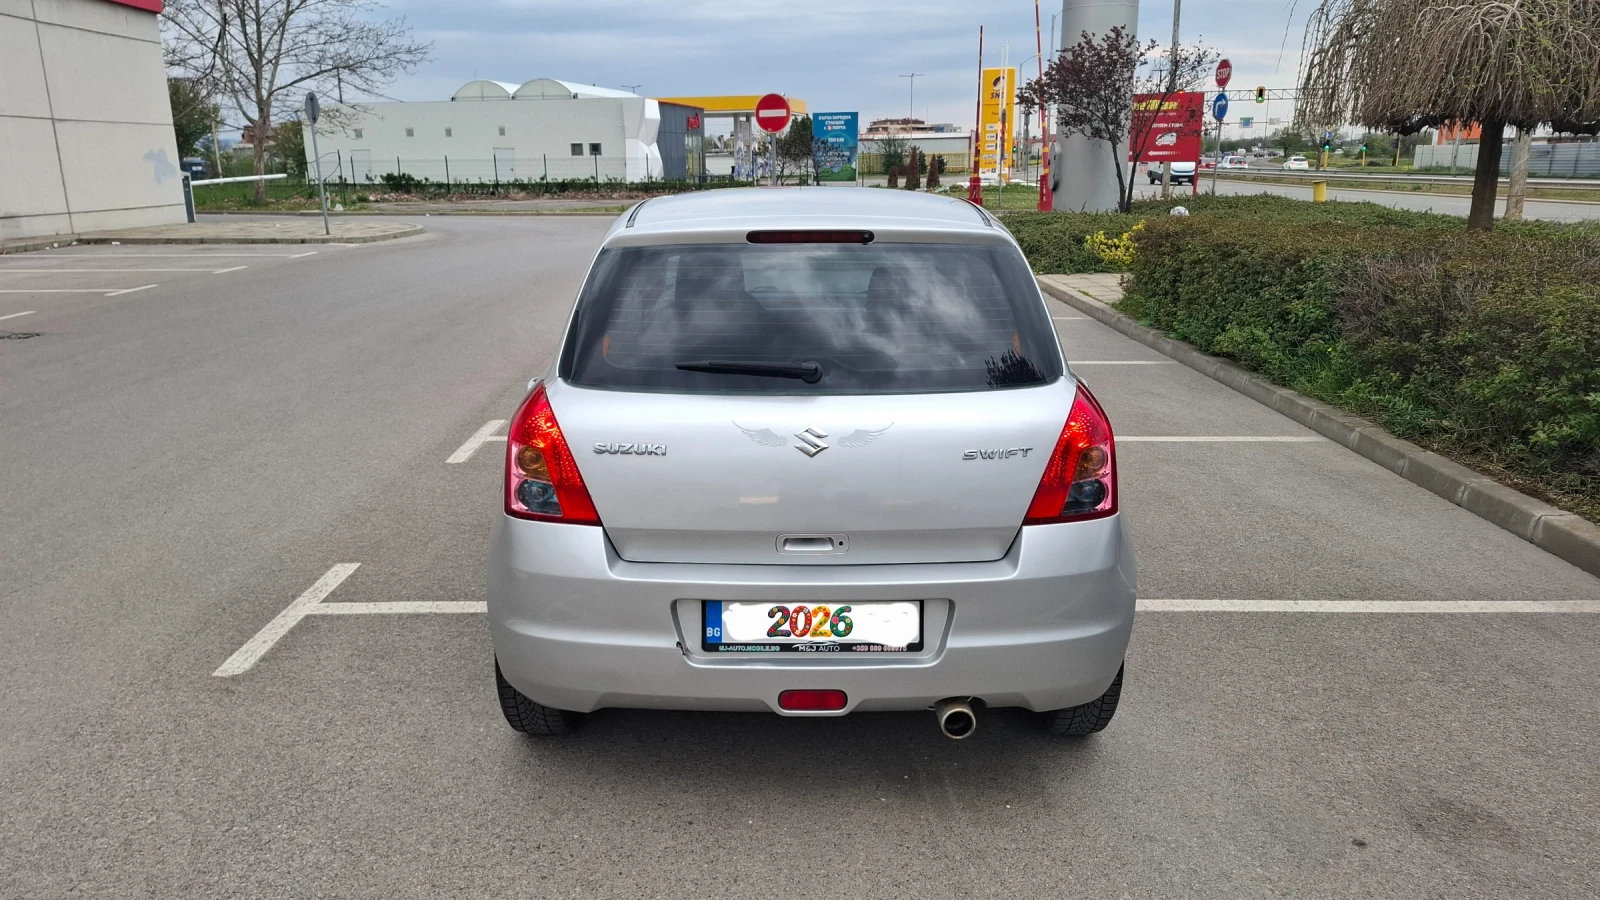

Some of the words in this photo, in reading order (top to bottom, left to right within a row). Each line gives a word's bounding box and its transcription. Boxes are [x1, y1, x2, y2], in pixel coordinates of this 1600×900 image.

[1216, 67, 1230, 80] STOP
[593, 442, 668, 457] SUZUKI
[962, 446, 1034, 461] SWIFT
[706, 627, 721, 637] BG
